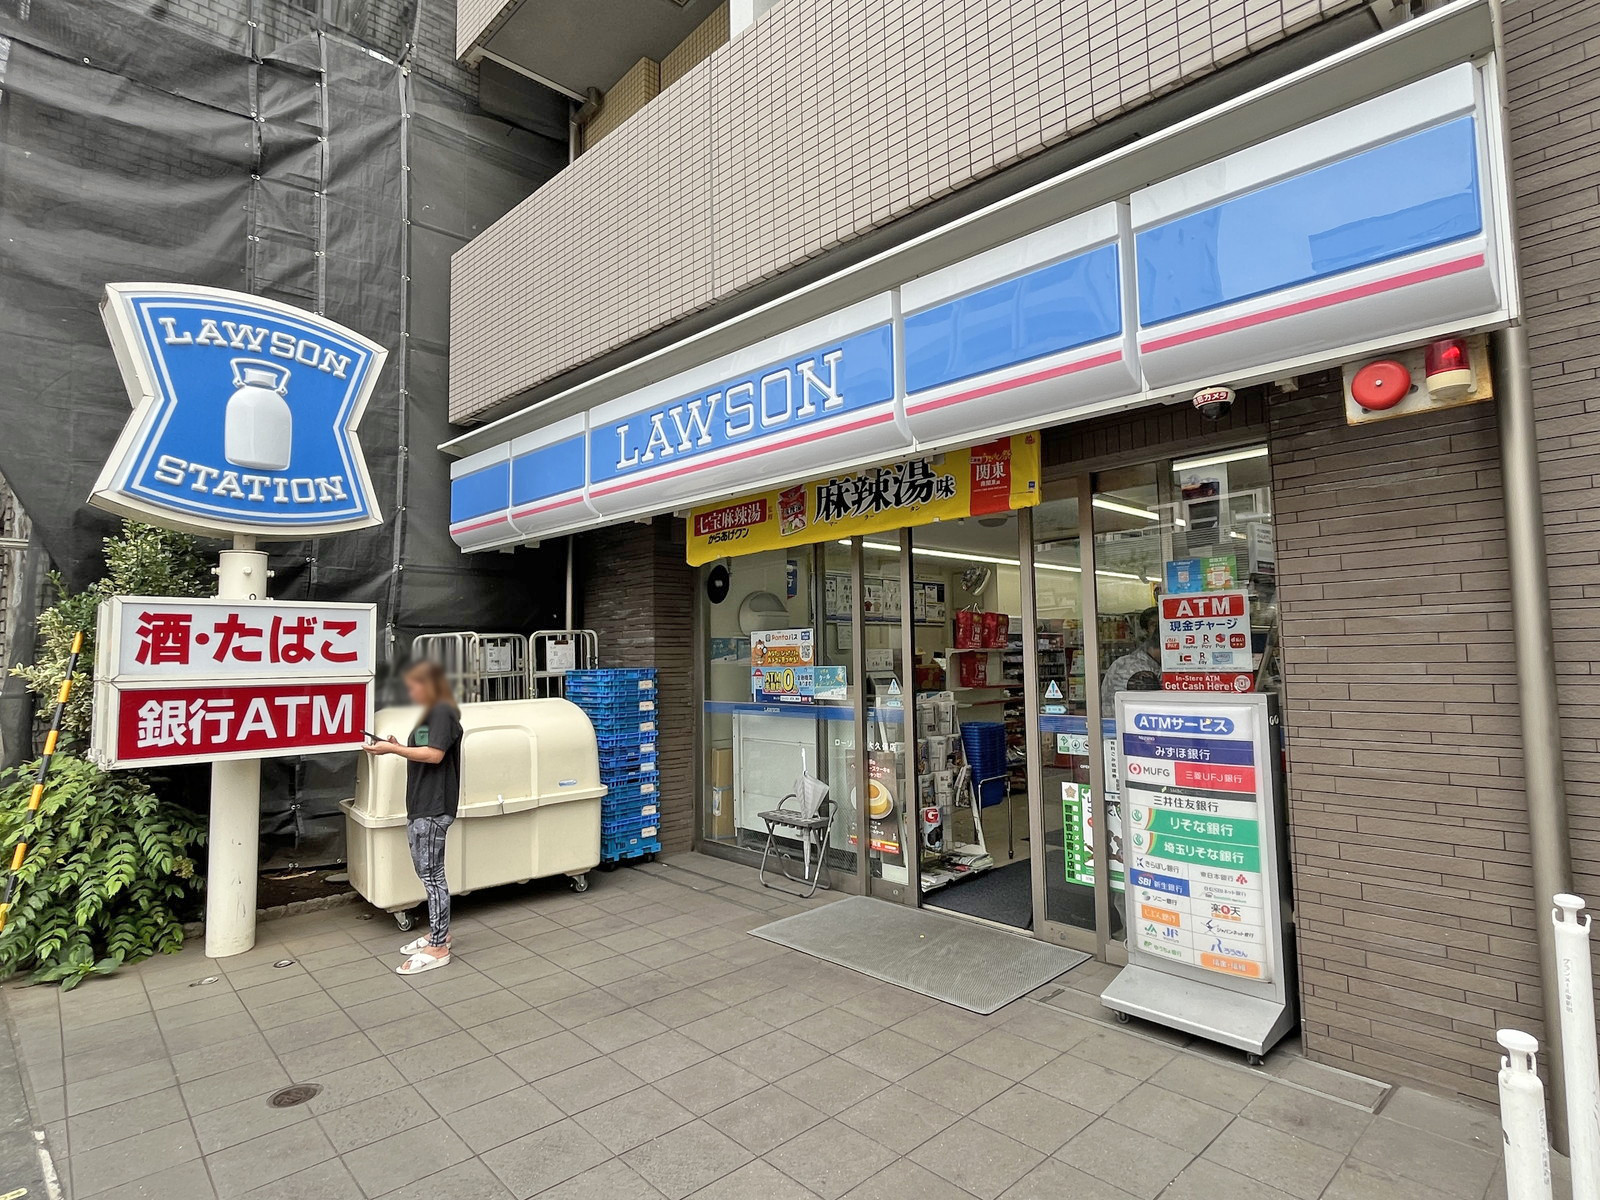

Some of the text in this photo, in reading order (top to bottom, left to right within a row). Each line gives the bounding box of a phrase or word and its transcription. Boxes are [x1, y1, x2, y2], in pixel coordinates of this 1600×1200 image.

[158, 317, 352, 380] LAWSON
[616, 348, 844, 471] LAWSON
[154, 455, 348, 503] STATION
[976, 461, 1006, 481] 関東
[700, 502, 761, 534] 七宝麻辣湯
[708, 528, 750, 544] からあげクン
[1176, 597, 1231, 617] ATM
[1169, 620, 1237, 631] 現金チャージ
[135, 611, 358, 665] 酒・たばこ
[765, 671, 781, 682] ATM
[1165, 682, 1234, 691] Get Cash Here!
[137, 694, 353, 748] 銀行ATM
[1139, 715, 1228, 733] ATMサービス
[1155, 746, 1211, 761] みずほ銀行
[1143, 763, 1170, 777] MUFG
[1185, 771, 1243, 784] 三菱UFJ銀行
[1153, 795, 1219, 813] 三井住友銀行
[1170, 817, 1234, 837] りそな銀行
[1164, 842, 1245, 865] 埼玉りそな銀行
[1144, 860, 1180, 874] きらぼし銀行
[1138, 876, 1183, 894] SBI 新生銀行
[1200, 871, 1234, 882] 東日本銀行
[1152, 894, 1178, 906] ソニー銀行
[1224, 947, 1249, 958] ろうきん
